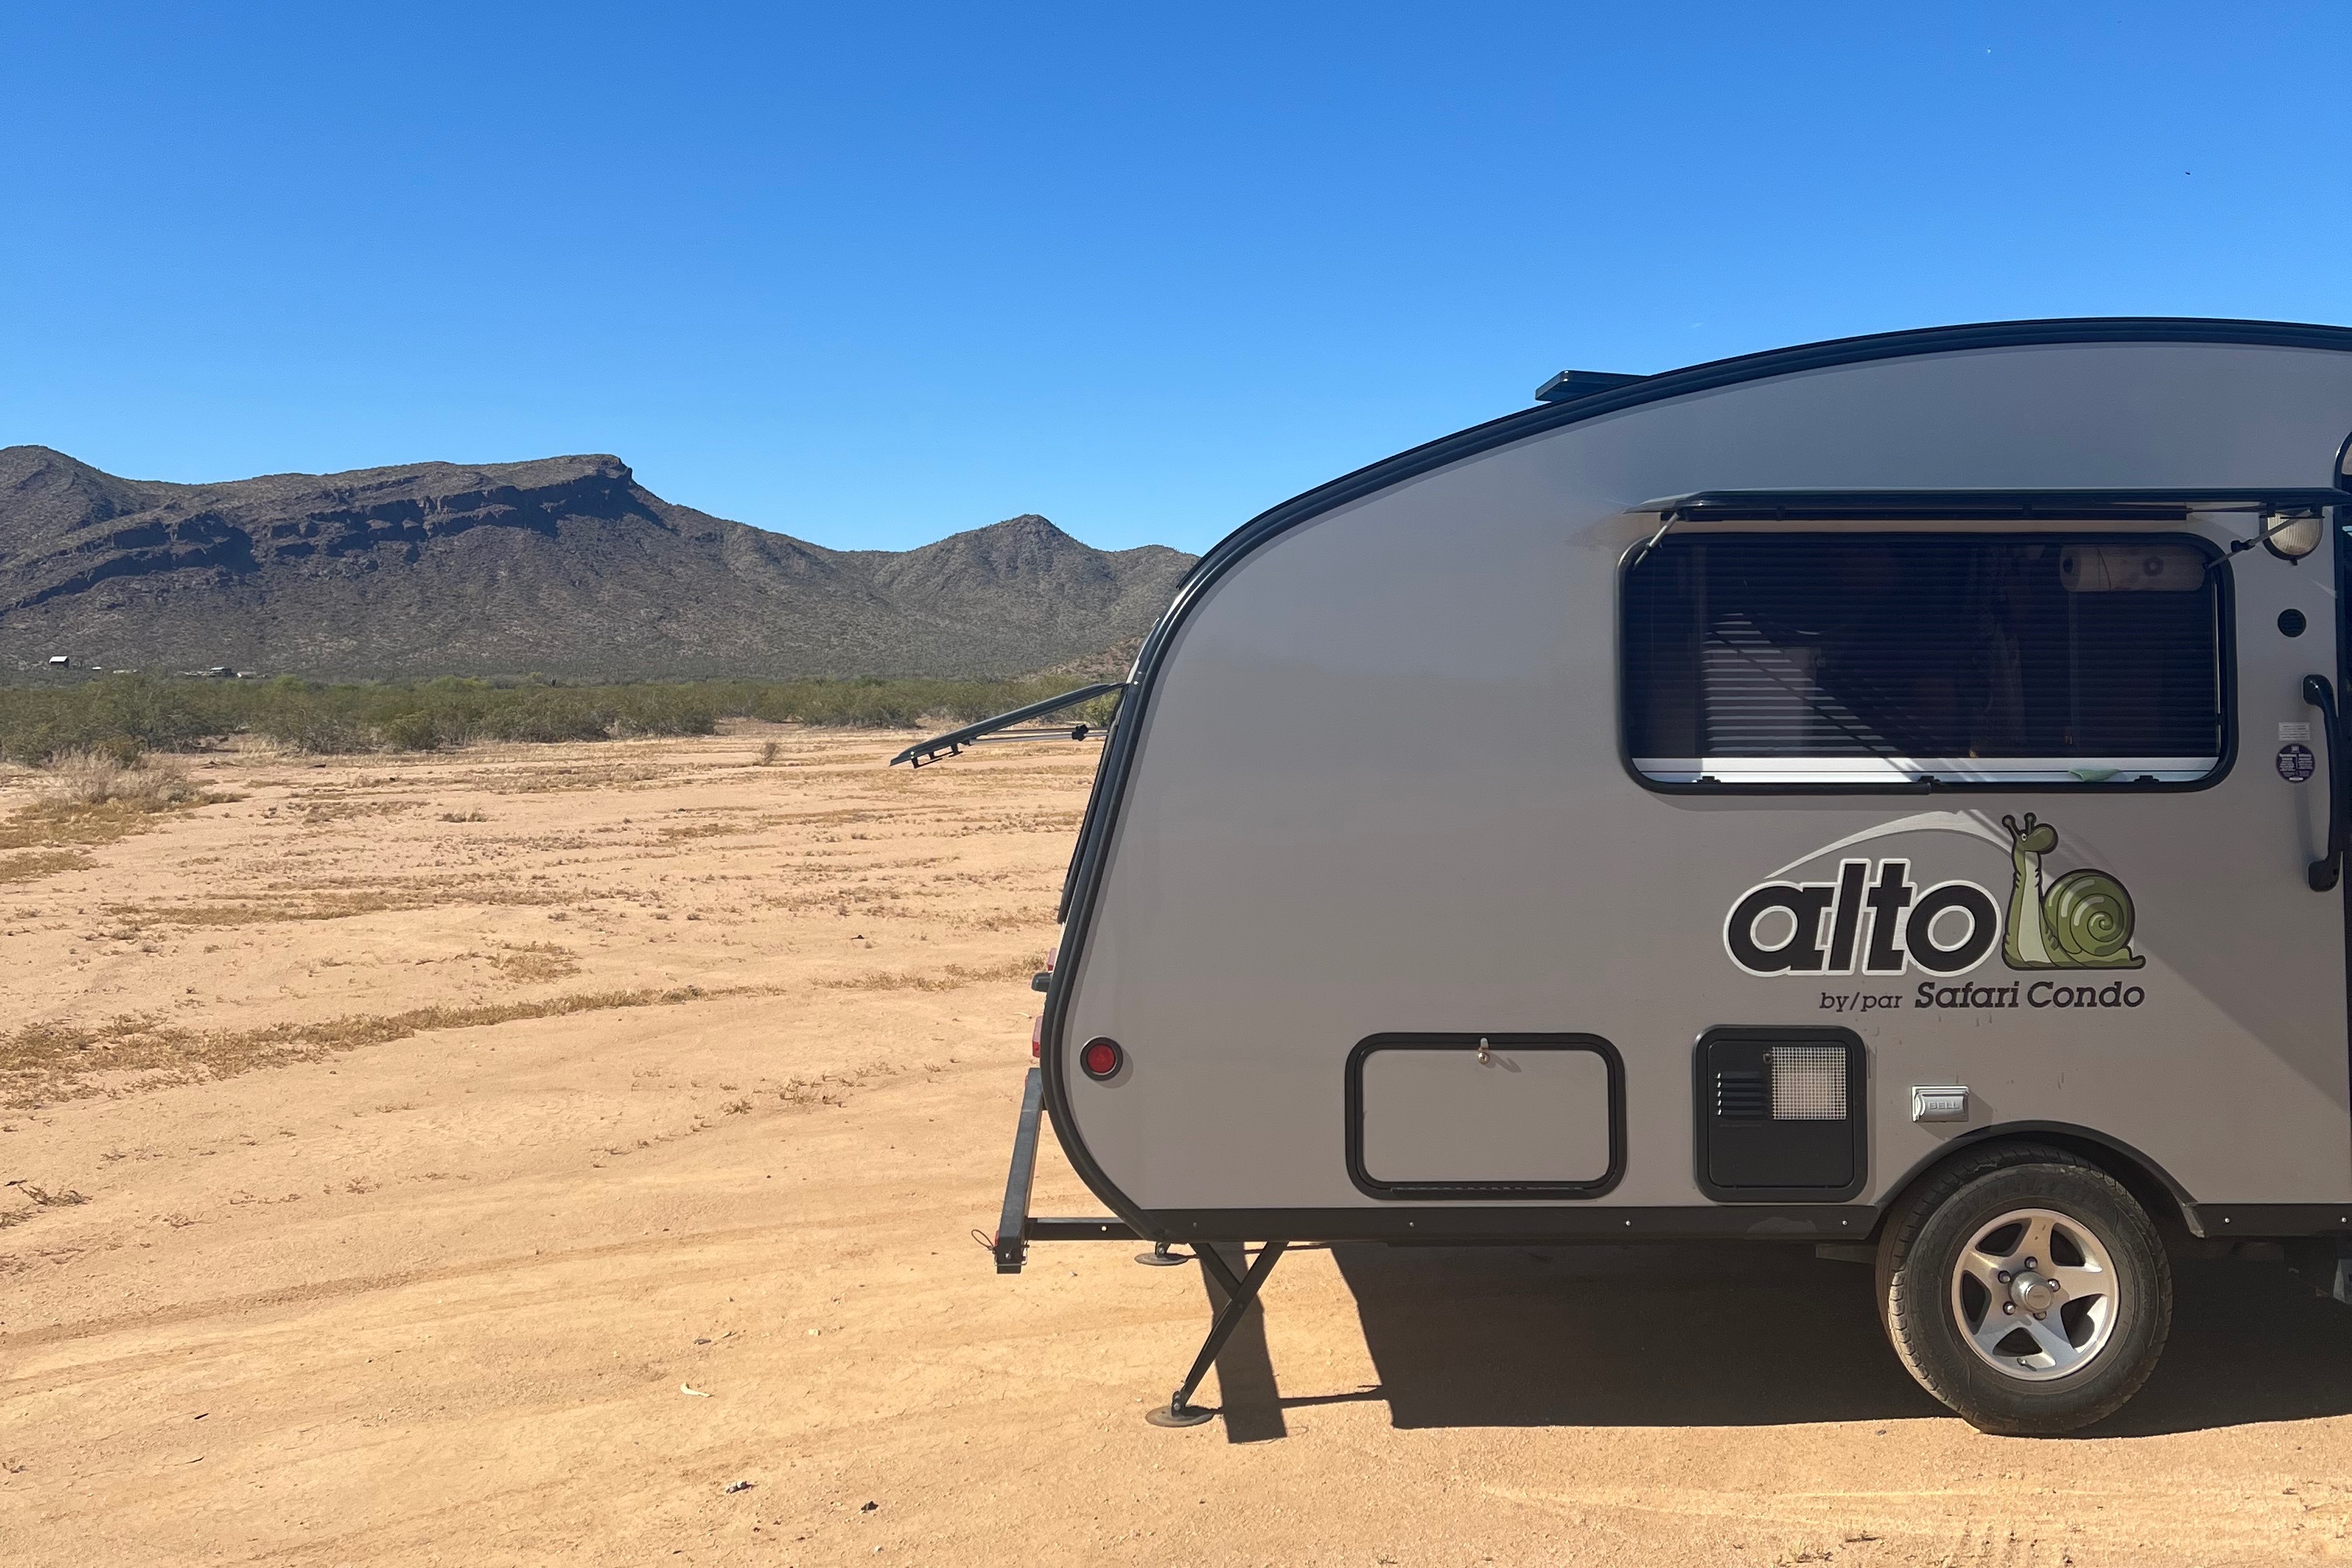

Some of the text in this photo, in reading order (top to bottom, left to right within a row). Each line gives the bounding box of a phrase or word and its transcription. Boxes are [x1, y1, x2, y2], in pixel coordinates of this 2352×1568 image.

[1724, 859, 2001, 976] alto
[1818, 981, 2145, 1013] by/par Safari Condo
[1928, 1101, 1961, 1111] BELL
